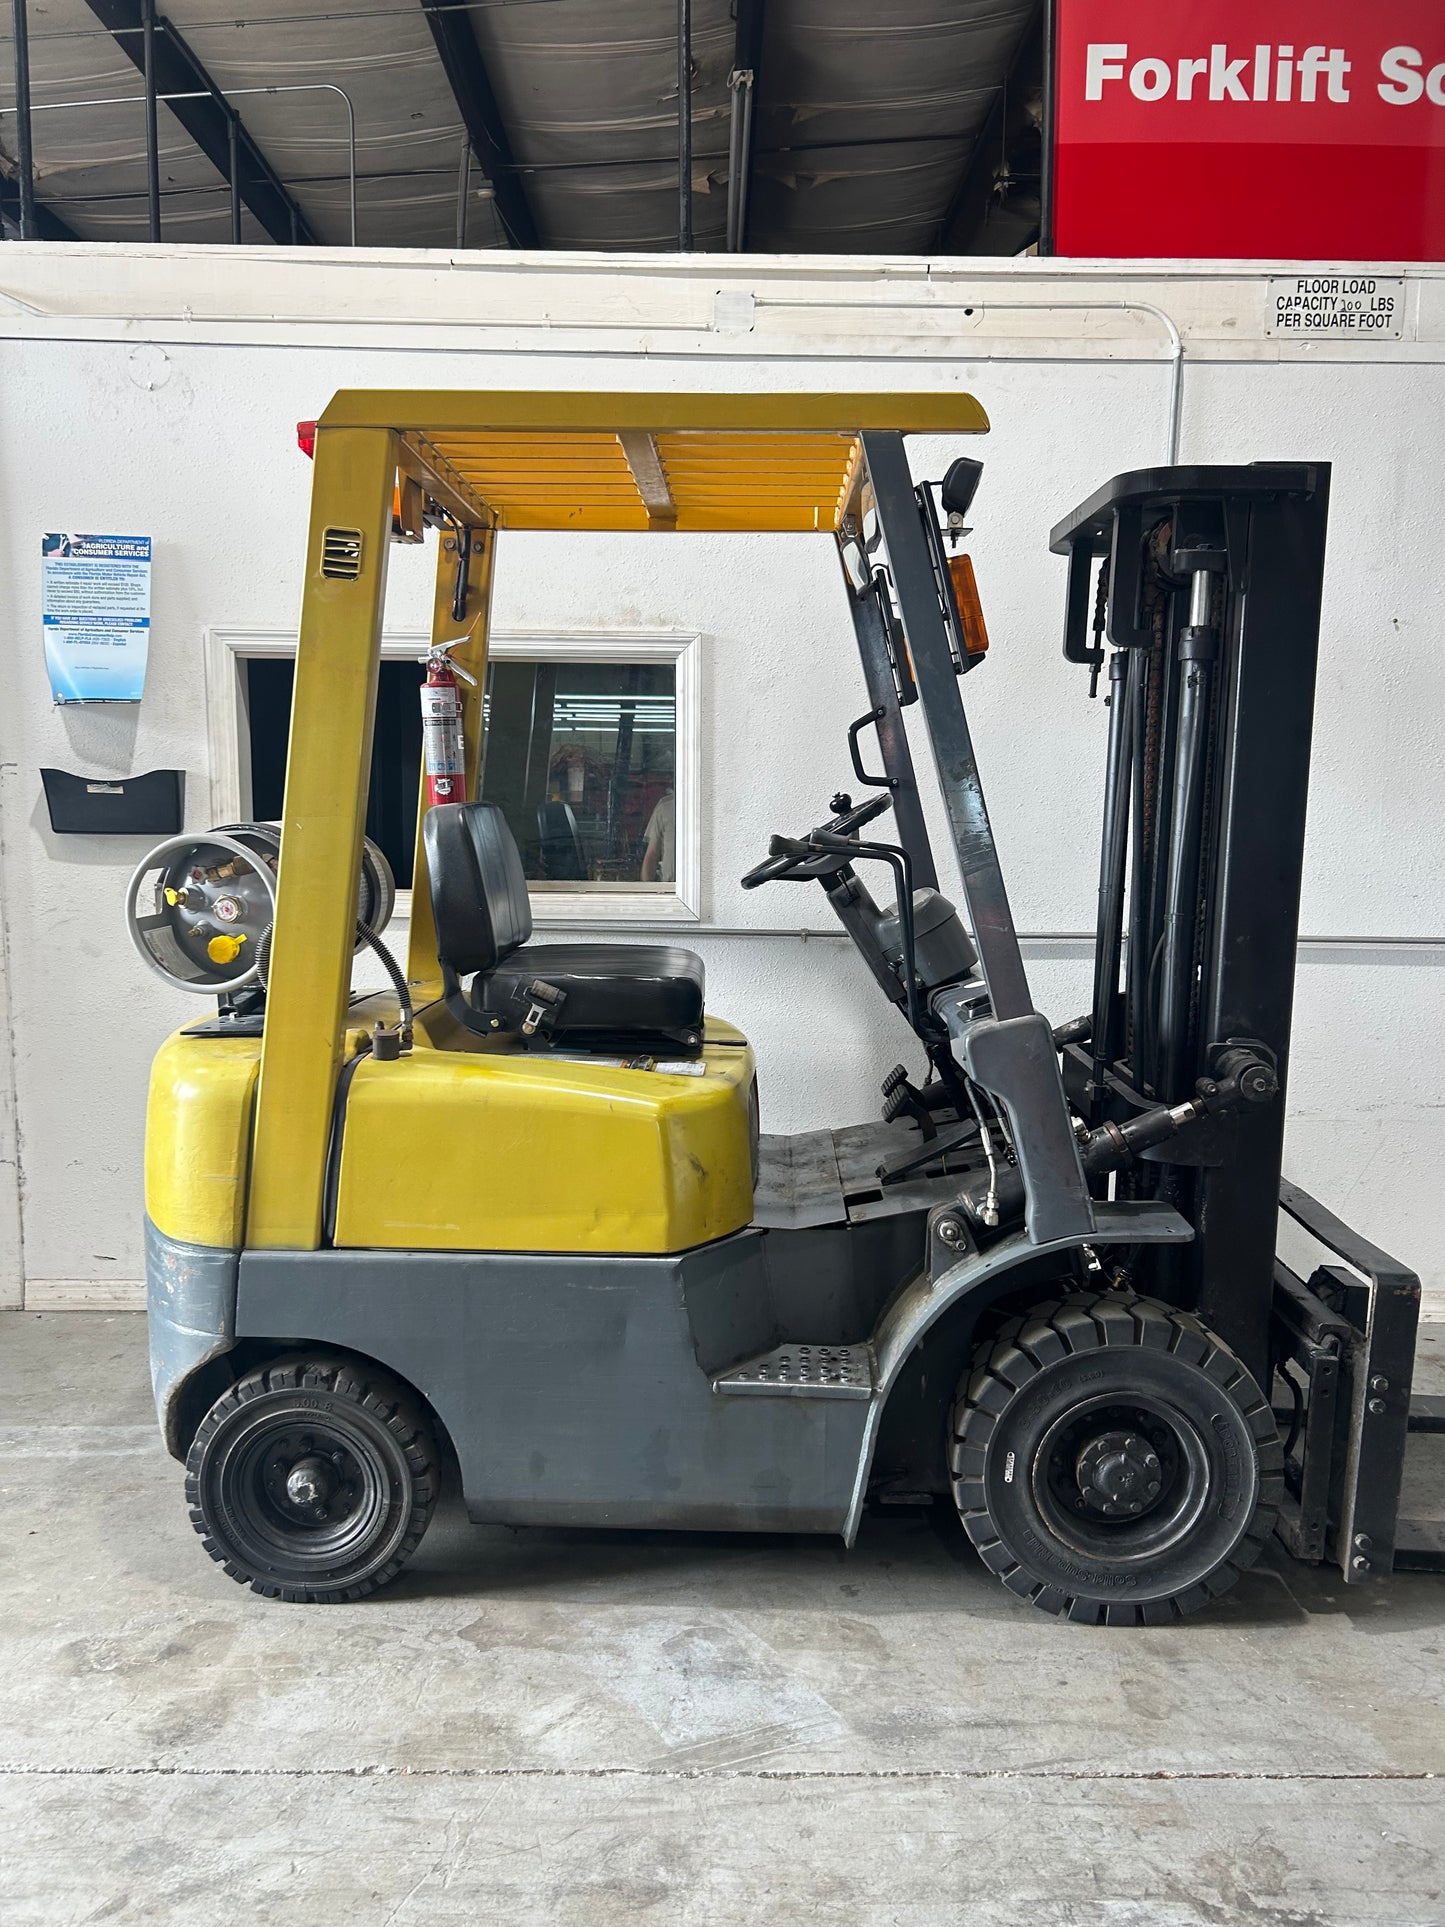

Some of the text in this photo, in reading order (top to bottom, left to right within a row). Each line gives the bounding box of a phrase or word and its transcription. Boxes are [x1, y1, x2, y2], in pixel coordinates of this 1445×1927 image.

[1085, 43, 1351, 103] Forklift
[1297, 279, 1376, 294] FLOOR LOAD
[1276, 296, 1338, 310] CAPACITY
[1370, 297, 1394, 311] LBS
[1276, 313, 1392, 328] PER SQUARE FOOT
[73, 548, 113, 556] CONSUMER
[86, 543, 135, 551] AGRICULTURE
